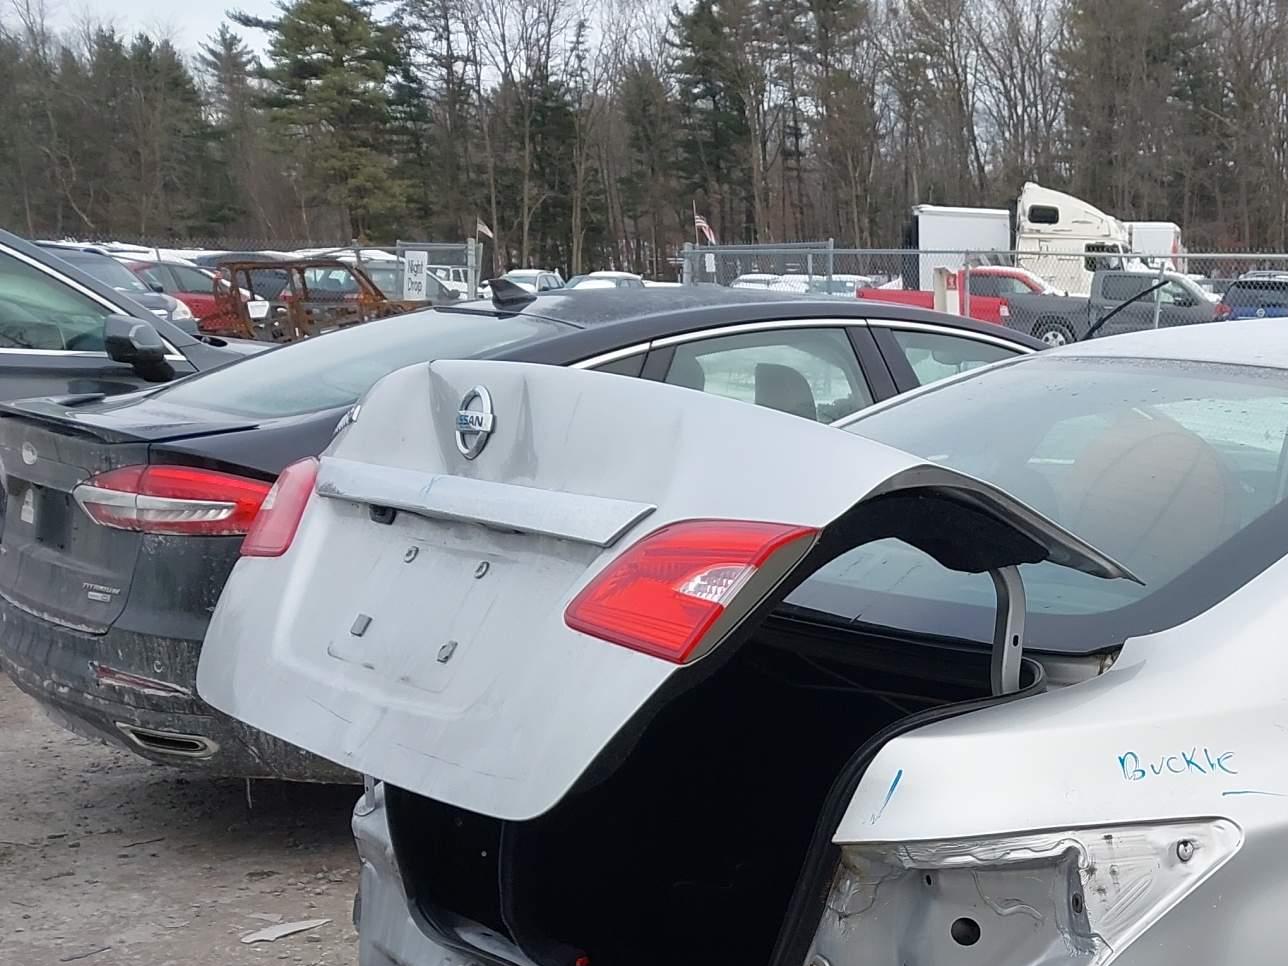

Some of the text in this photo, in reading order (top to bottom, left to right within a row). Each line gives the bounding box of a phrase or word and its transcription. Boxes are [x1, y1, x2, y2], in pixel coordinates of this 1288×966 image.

[407, 259, 424, 276] Night
[407, 277, 423, 294] Drop
[457, 414, 484, 428] SSAN
